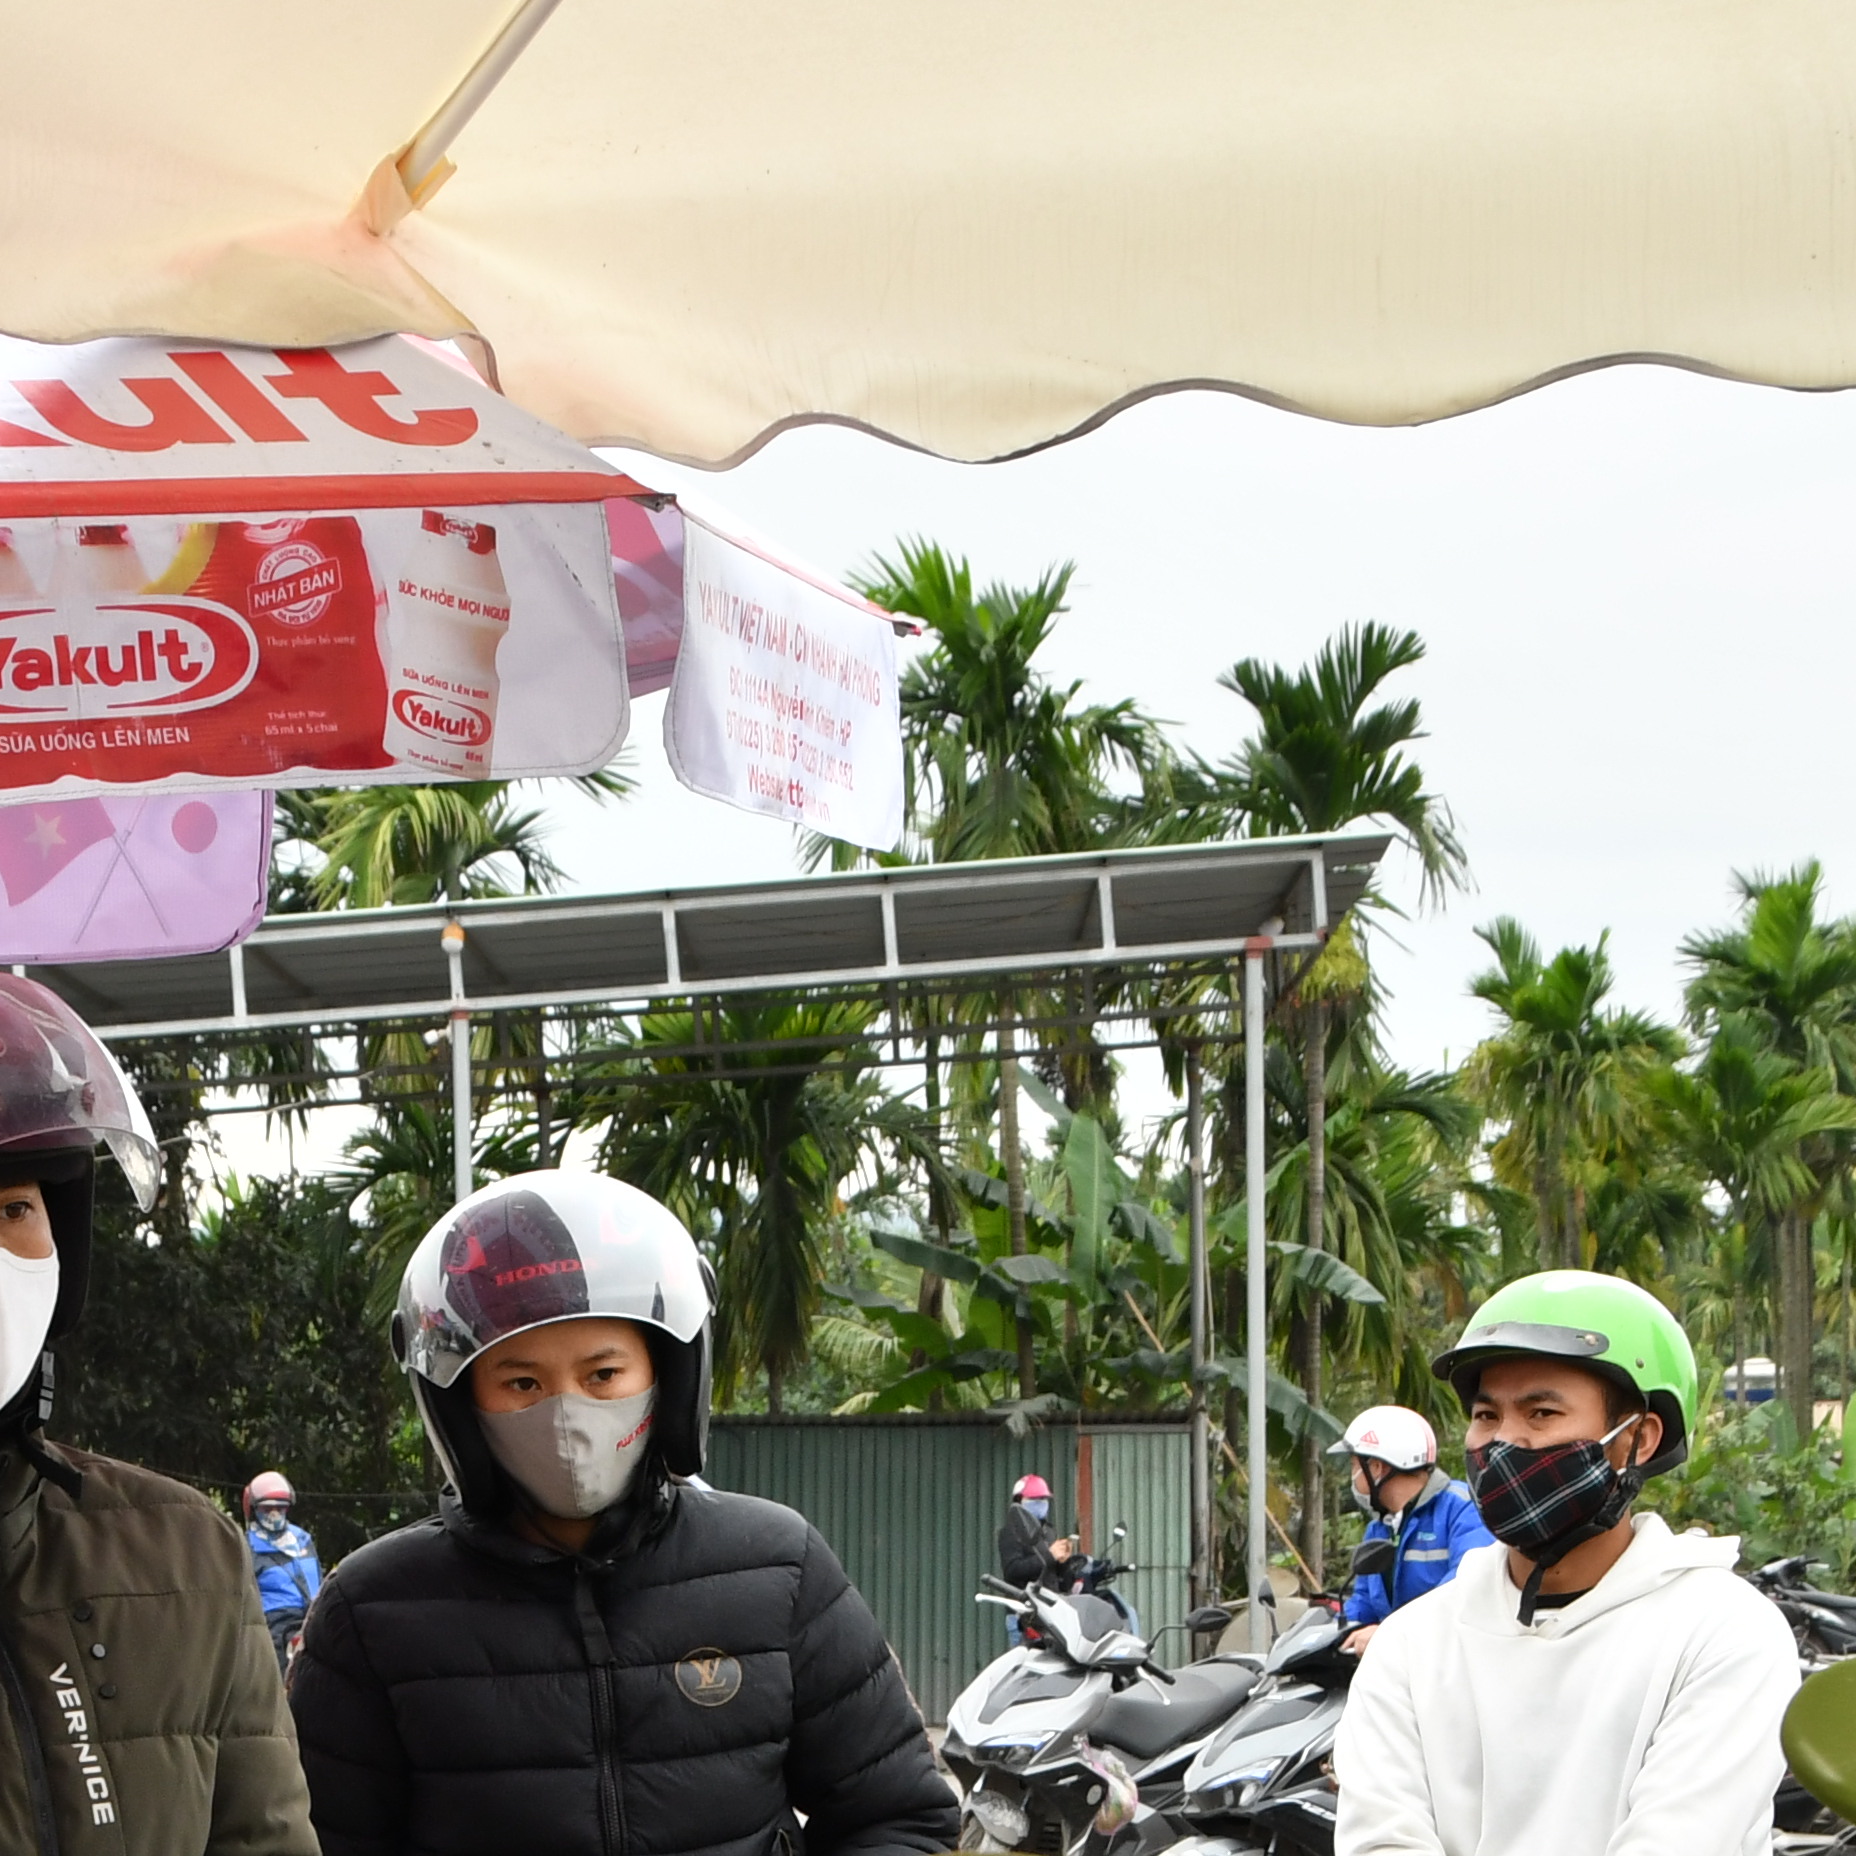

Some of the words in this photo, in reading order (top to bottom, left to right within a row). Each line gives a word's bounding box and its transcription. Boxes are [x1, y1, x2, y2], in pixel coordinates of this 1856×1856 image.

[299, 567, 335, 595] BẢN
[407, 698, 478, 740] Yakult
[40, 725, 96, 752] UỐNG
[102, 725, 141, 748] LÊN
[147, 726, 191, 746] MEN
